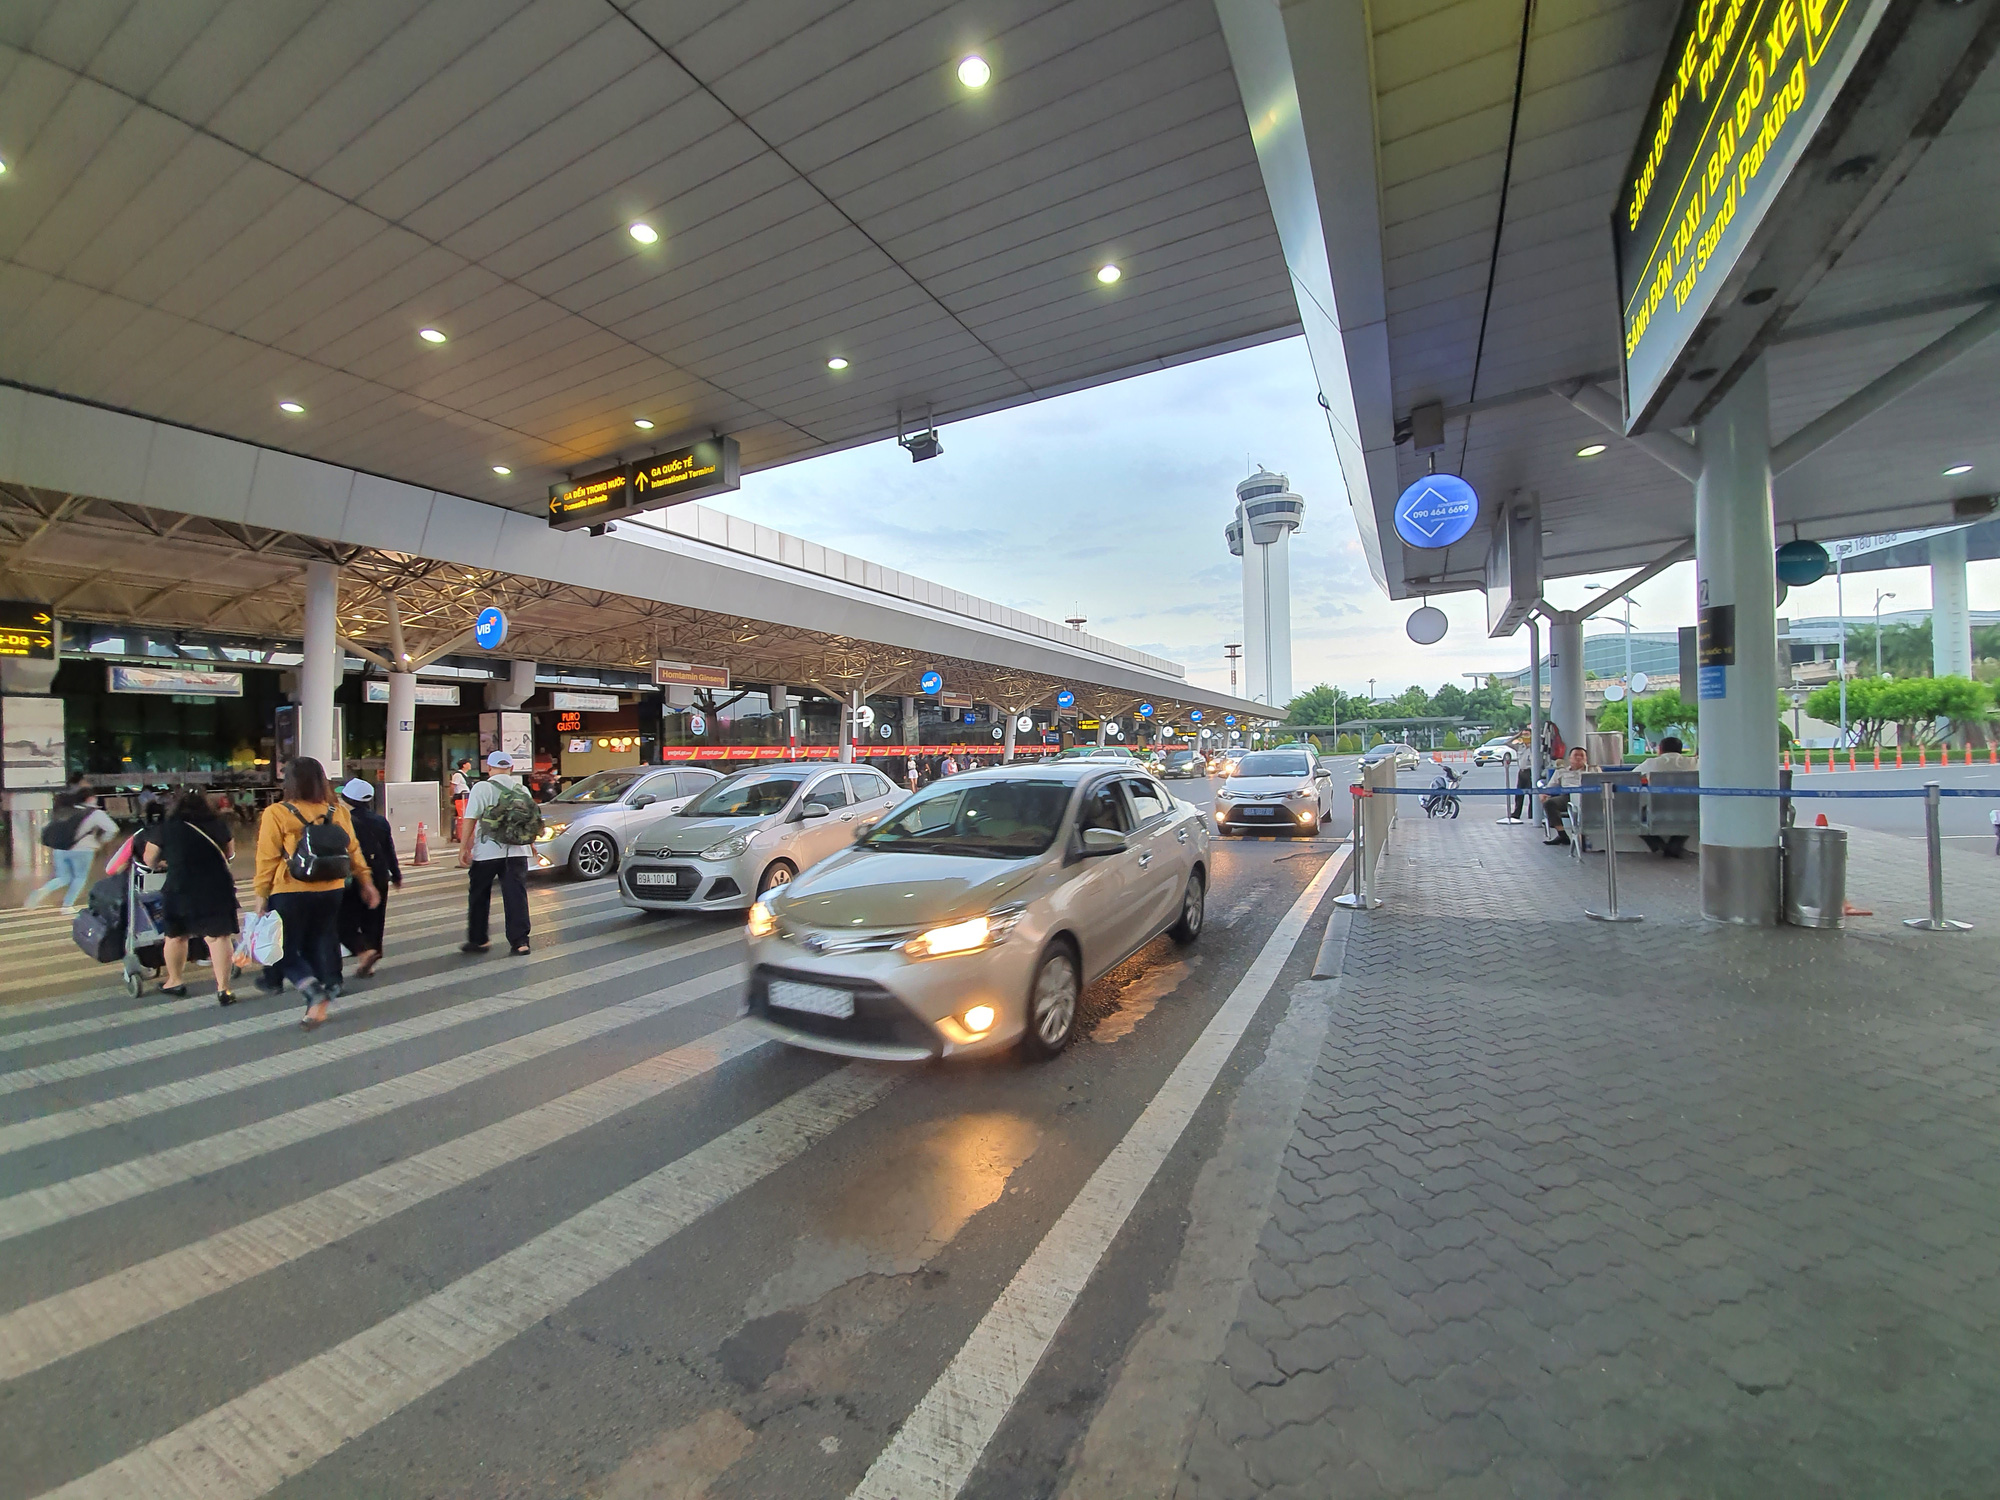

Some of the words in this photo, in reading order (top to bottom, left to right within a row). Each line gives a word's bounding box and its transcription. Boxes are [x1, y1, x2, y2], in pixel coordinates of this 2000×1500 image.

[1629, 151, 1655, 232] SẢNH
[1654, 83, 1678, 167] ĐÓN
[1677, 31, 1698, 101] XE
[1625, 297, 1651, 360] SẢNH
[1650, 250, 1673, 315] ĐÓN
[1672, 192, 1701, 266] TAXI
[1708, 117, 1736, 197] BÃI
[1736, 41, 1765, 138] ĐỖ
[1766, 0, 1798, 77] XE
[1673, 255, 1697, 313] Taxi
[1738, 57, 1807, 198] Parking
[651, 467, 662, 477] GA
[662, 459, 683, 474] QUỐC
[682, 455, 693, 469] TẾ
[651, 472, 688, 488] International
[688, 464, 716, 479] Terminal
[563, 493, 573, 501] GA
[572, 486, 586, 500] ĐẾN
[586, 482, 607, 495] TRONG
[607, 476, 626, 489] NƯỚC
[563, 499, 587, 511] Domestic
[1413, 510, 1429, 518] 090
[1430, 508, 1446, 516] 464
[1448, 504, 1469, 514] 6699
[477, 623, 491, 636] VIB
[662, 670, 698, 681] Homtamin
[698, 673, 725, 685] Ginseng
[561, 712, 580, 721] PURO
[557, 721, 580, 731] GUSTO
